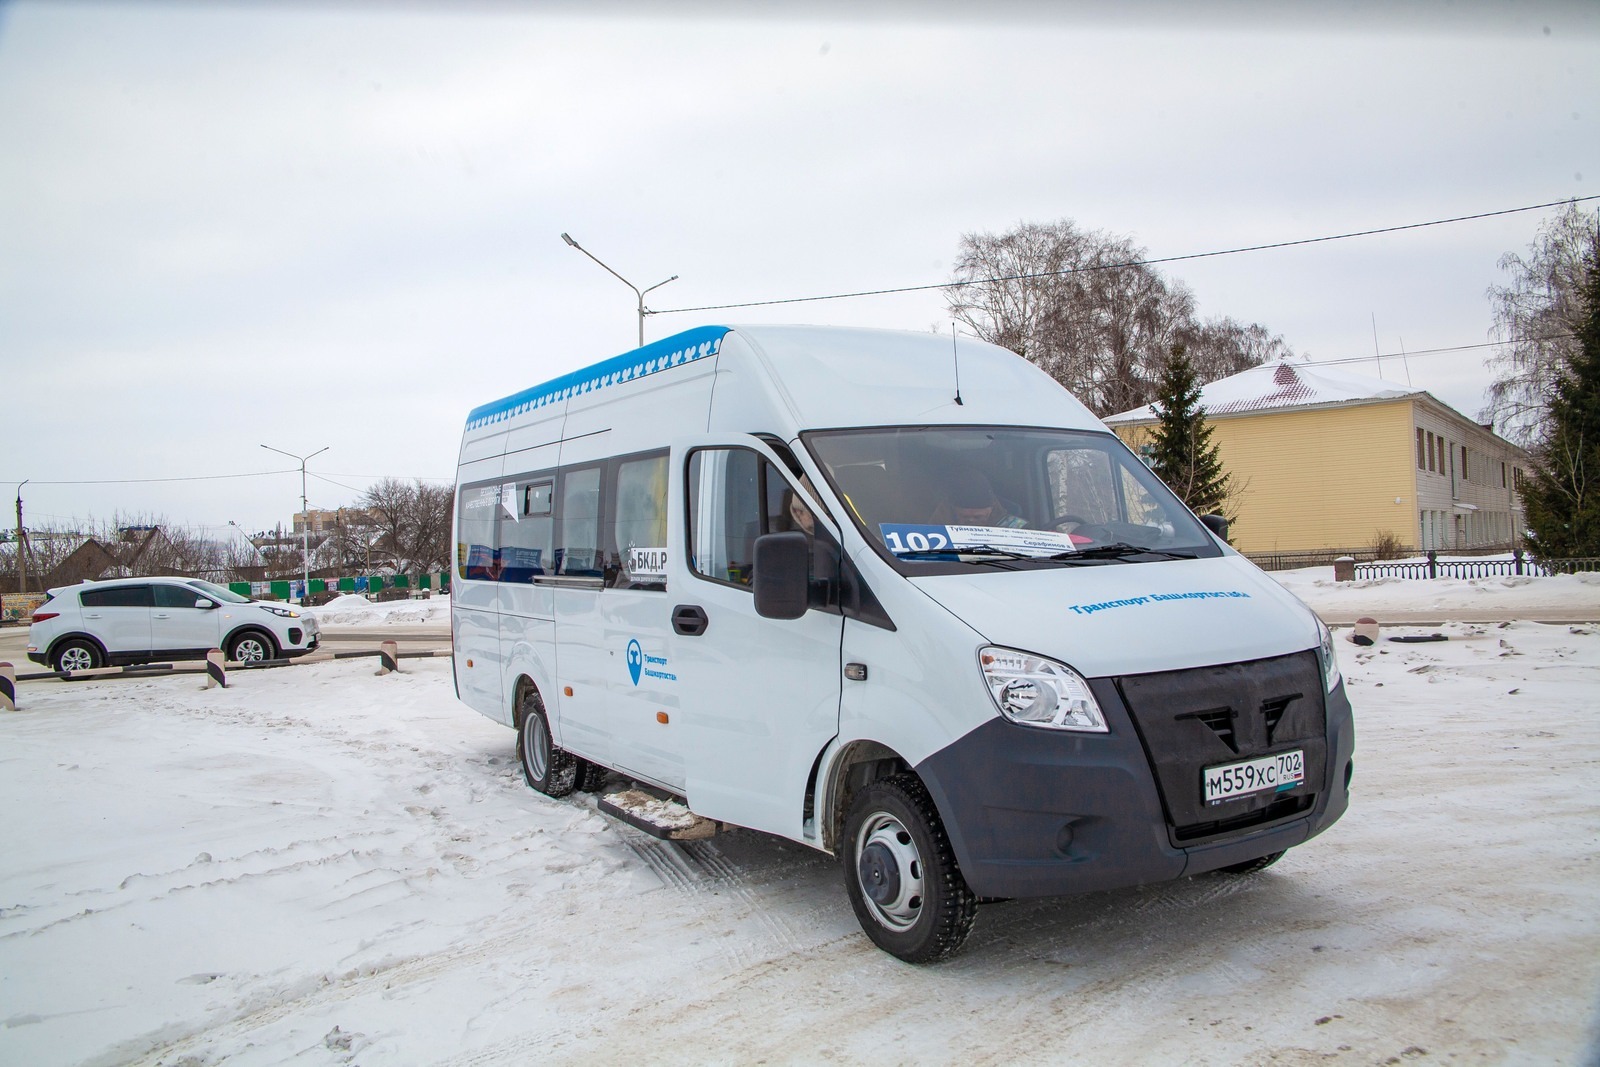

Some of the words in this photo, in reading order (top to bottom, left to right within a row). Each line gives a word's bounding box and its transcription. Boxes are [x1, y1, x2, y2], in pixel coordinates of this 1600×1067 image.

[886, 532, 947, 552] 102
[1068, 596, 1150, 614] Транспорт
[644, 654, 667, 666] Транспорт
[1210, 765, 1275, 796] М559ХС
[1278, 754, 1300, 774] 702
